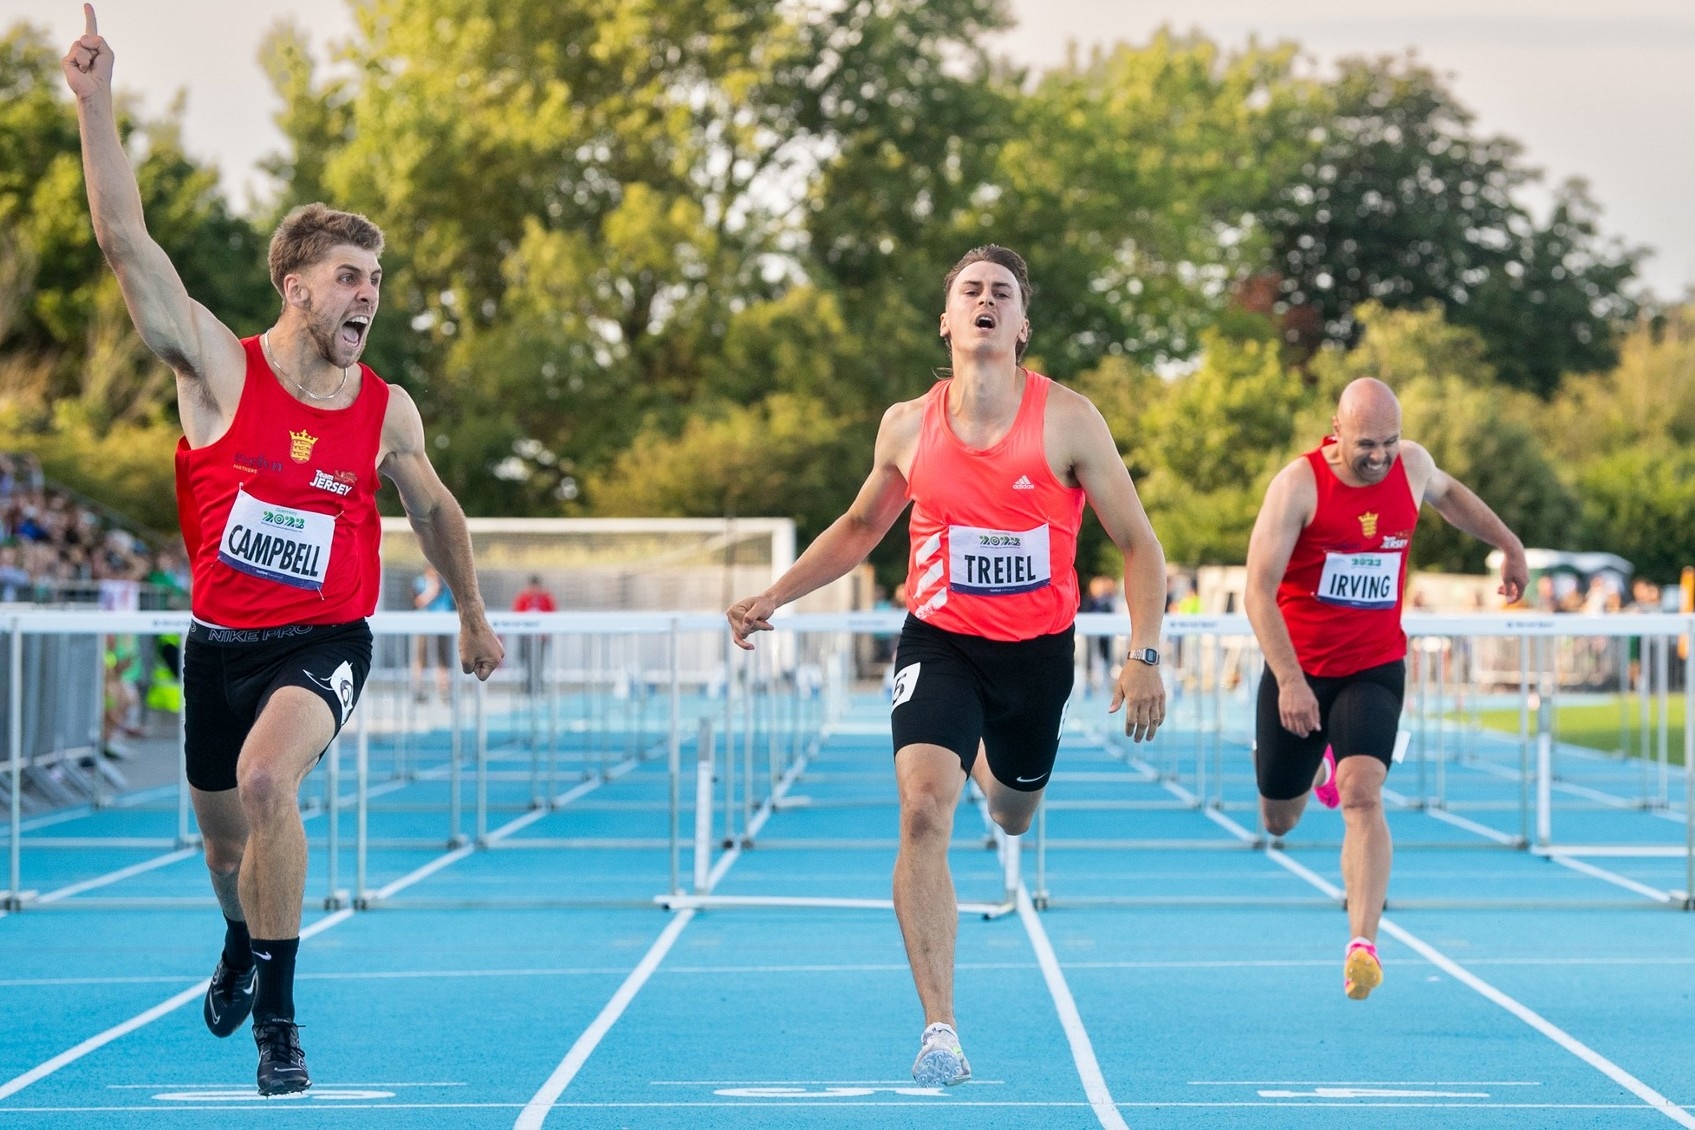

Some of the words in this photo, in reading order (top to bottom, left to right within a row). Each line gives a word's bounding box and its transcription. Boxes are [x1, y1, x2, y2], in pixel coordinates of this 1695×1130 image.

[315, 469, 334, 480] Team
[309, 477, 352, 496] JERSEY
[261, 511, 305, 529] 2023
[979, 535, 1021, 546] 2023
[228, 524, 320, 577] CAMPBELL
[964, 554, 1036, 584] TREIEL
[1330, 573, 1391, 599] IRVING
[208, 628, 260, 643] NIKE
[262, 625, 313, 641] PRO
